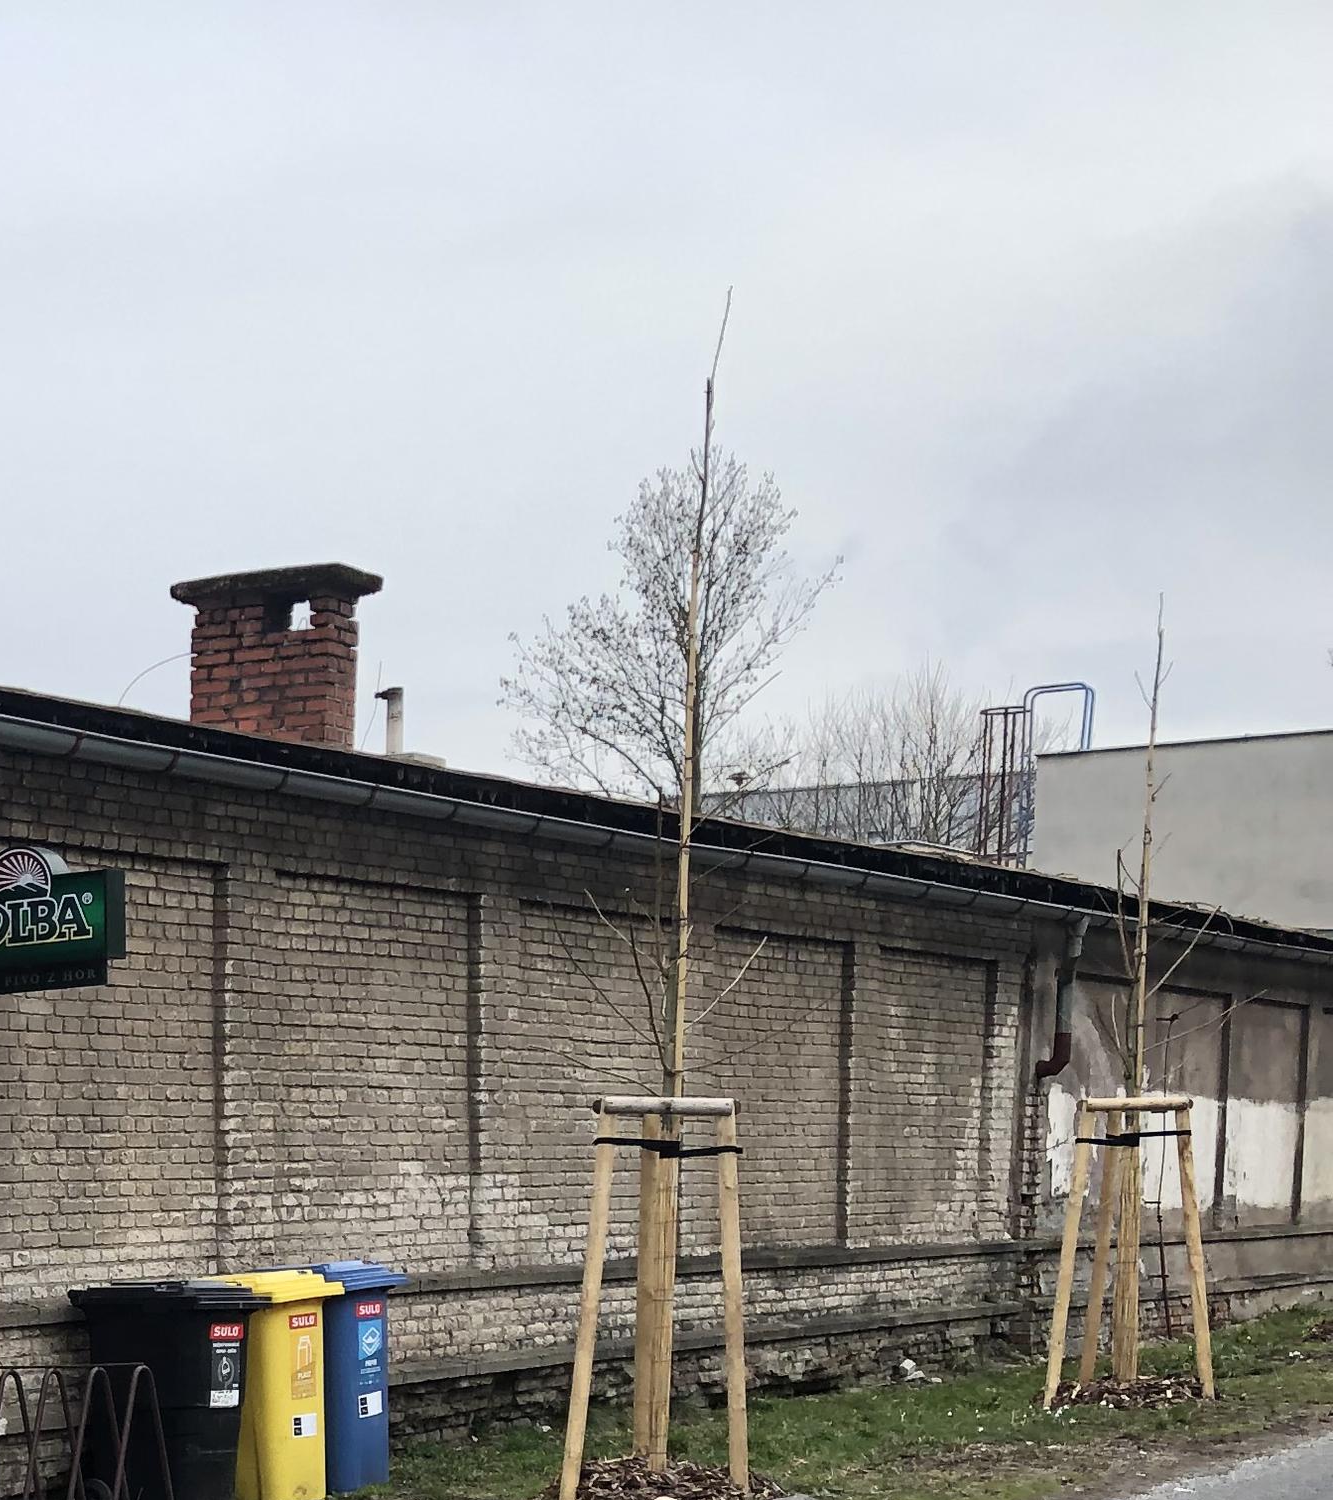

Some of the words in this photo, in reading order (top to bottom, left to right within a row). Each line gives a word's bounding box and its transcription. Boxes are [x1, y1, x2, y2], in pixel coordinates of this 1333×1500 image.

[63, 968, 97, 982] HOR
[358, 1303, 381, 1316] SULO
[291, 1315, 315, 1328] SULO
[213, 1325, 240, 1337] SULO
